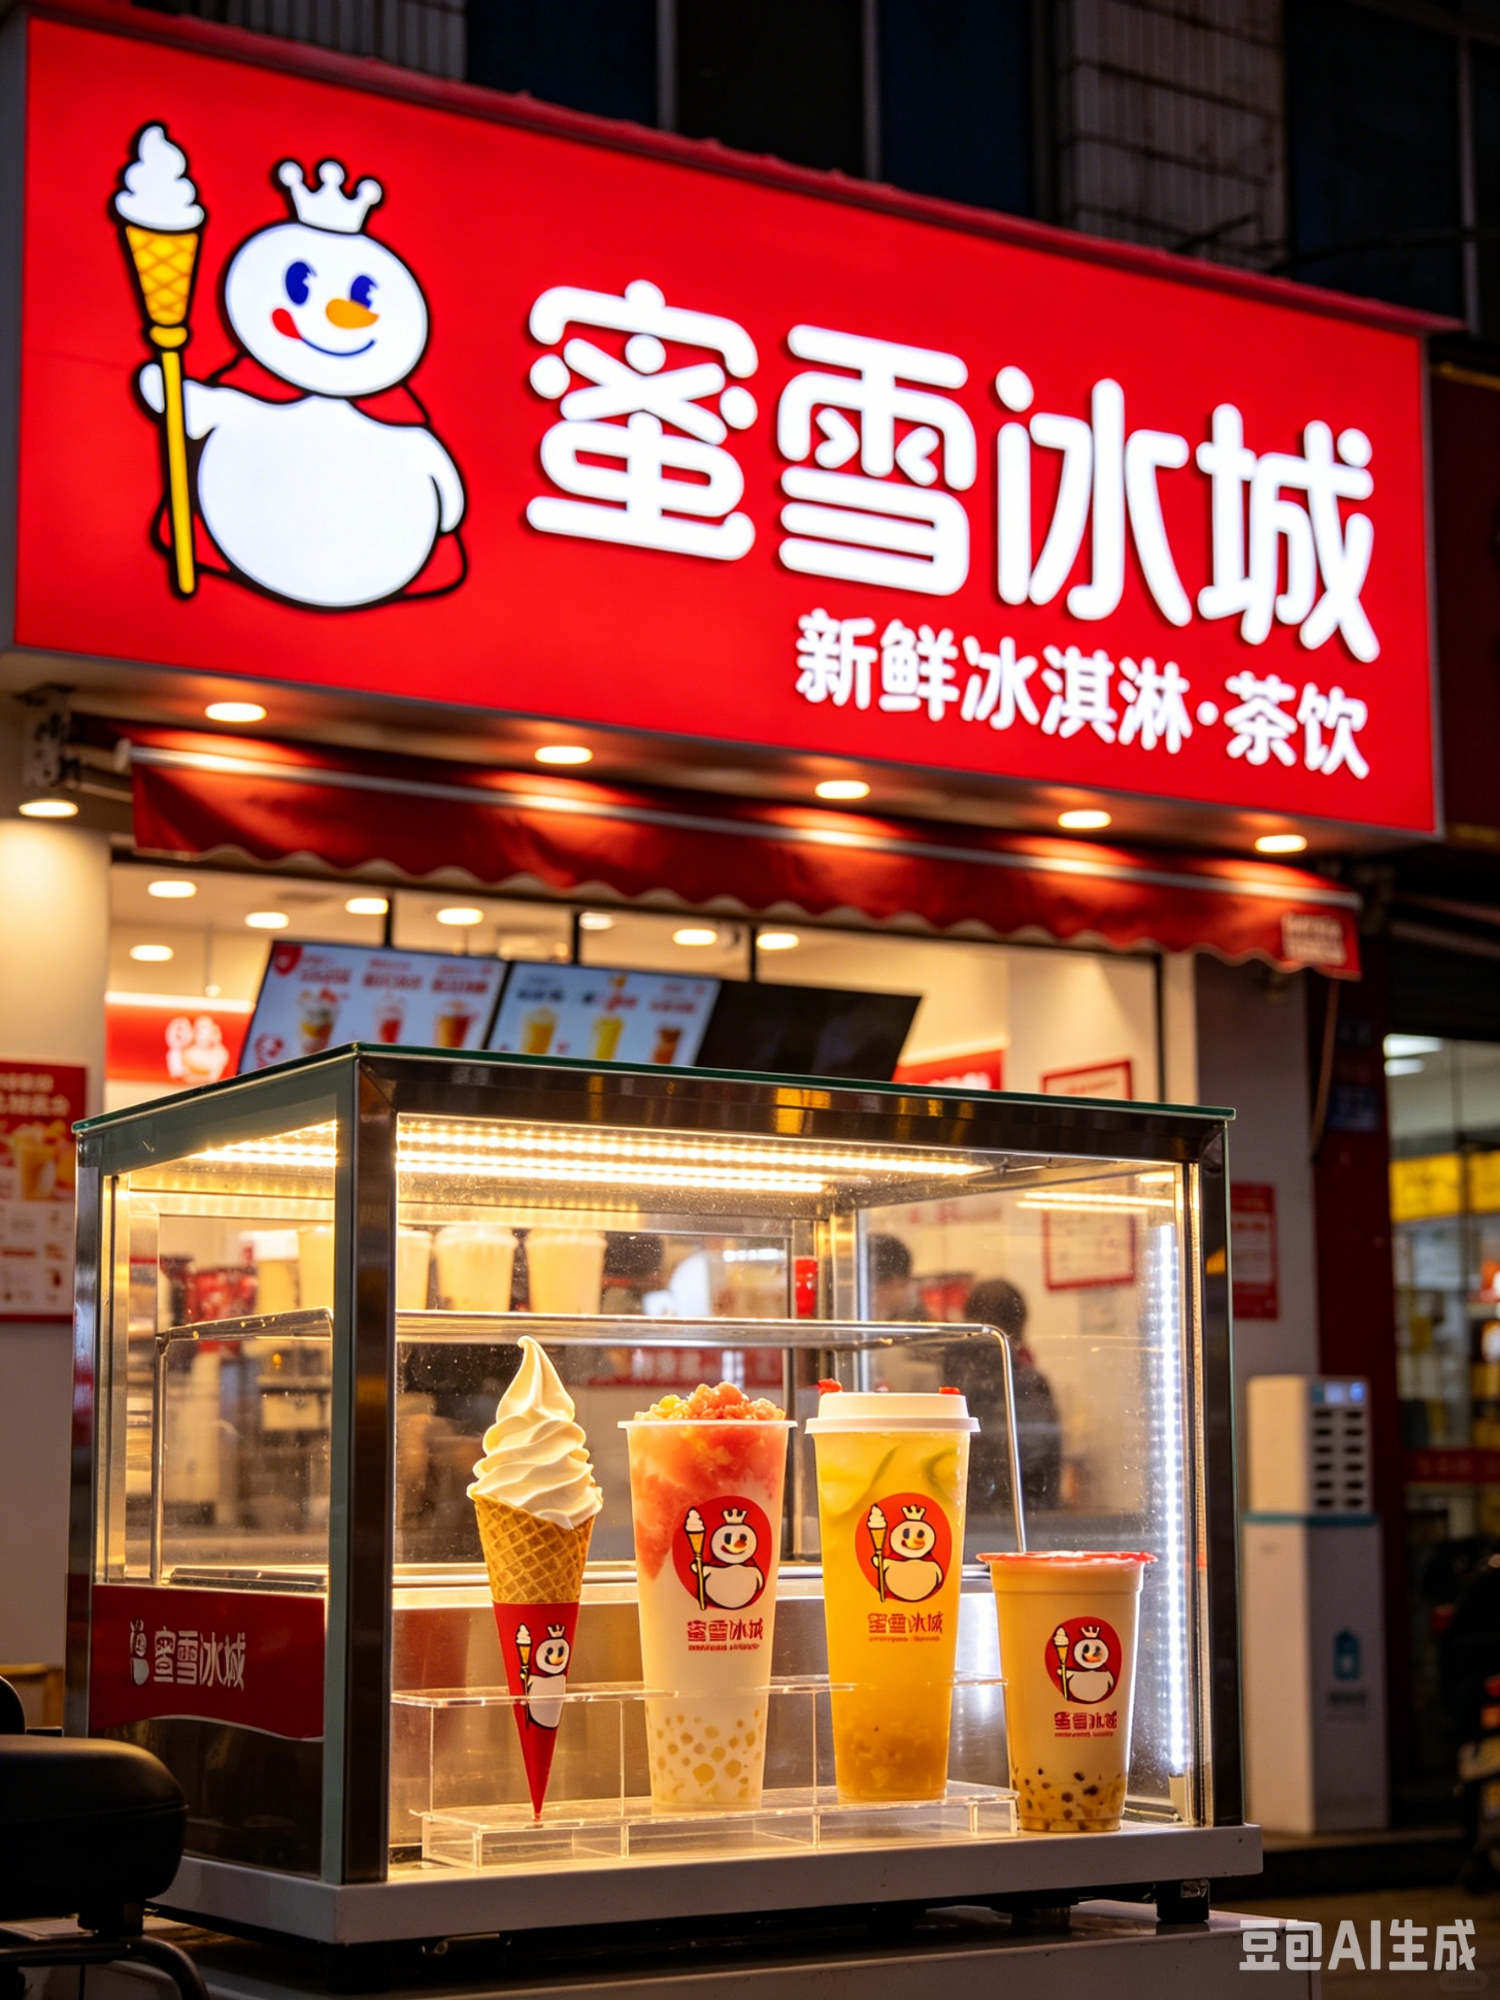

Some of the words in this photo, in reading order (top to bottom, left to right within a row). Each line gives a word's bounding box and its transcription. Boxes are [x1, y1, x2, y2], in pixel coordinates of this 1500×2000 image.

[527, 280, 1380, 663] 蜜雪冰城
[795, 608, 1370, 779] 新鲜冰淇淋·茶饮
